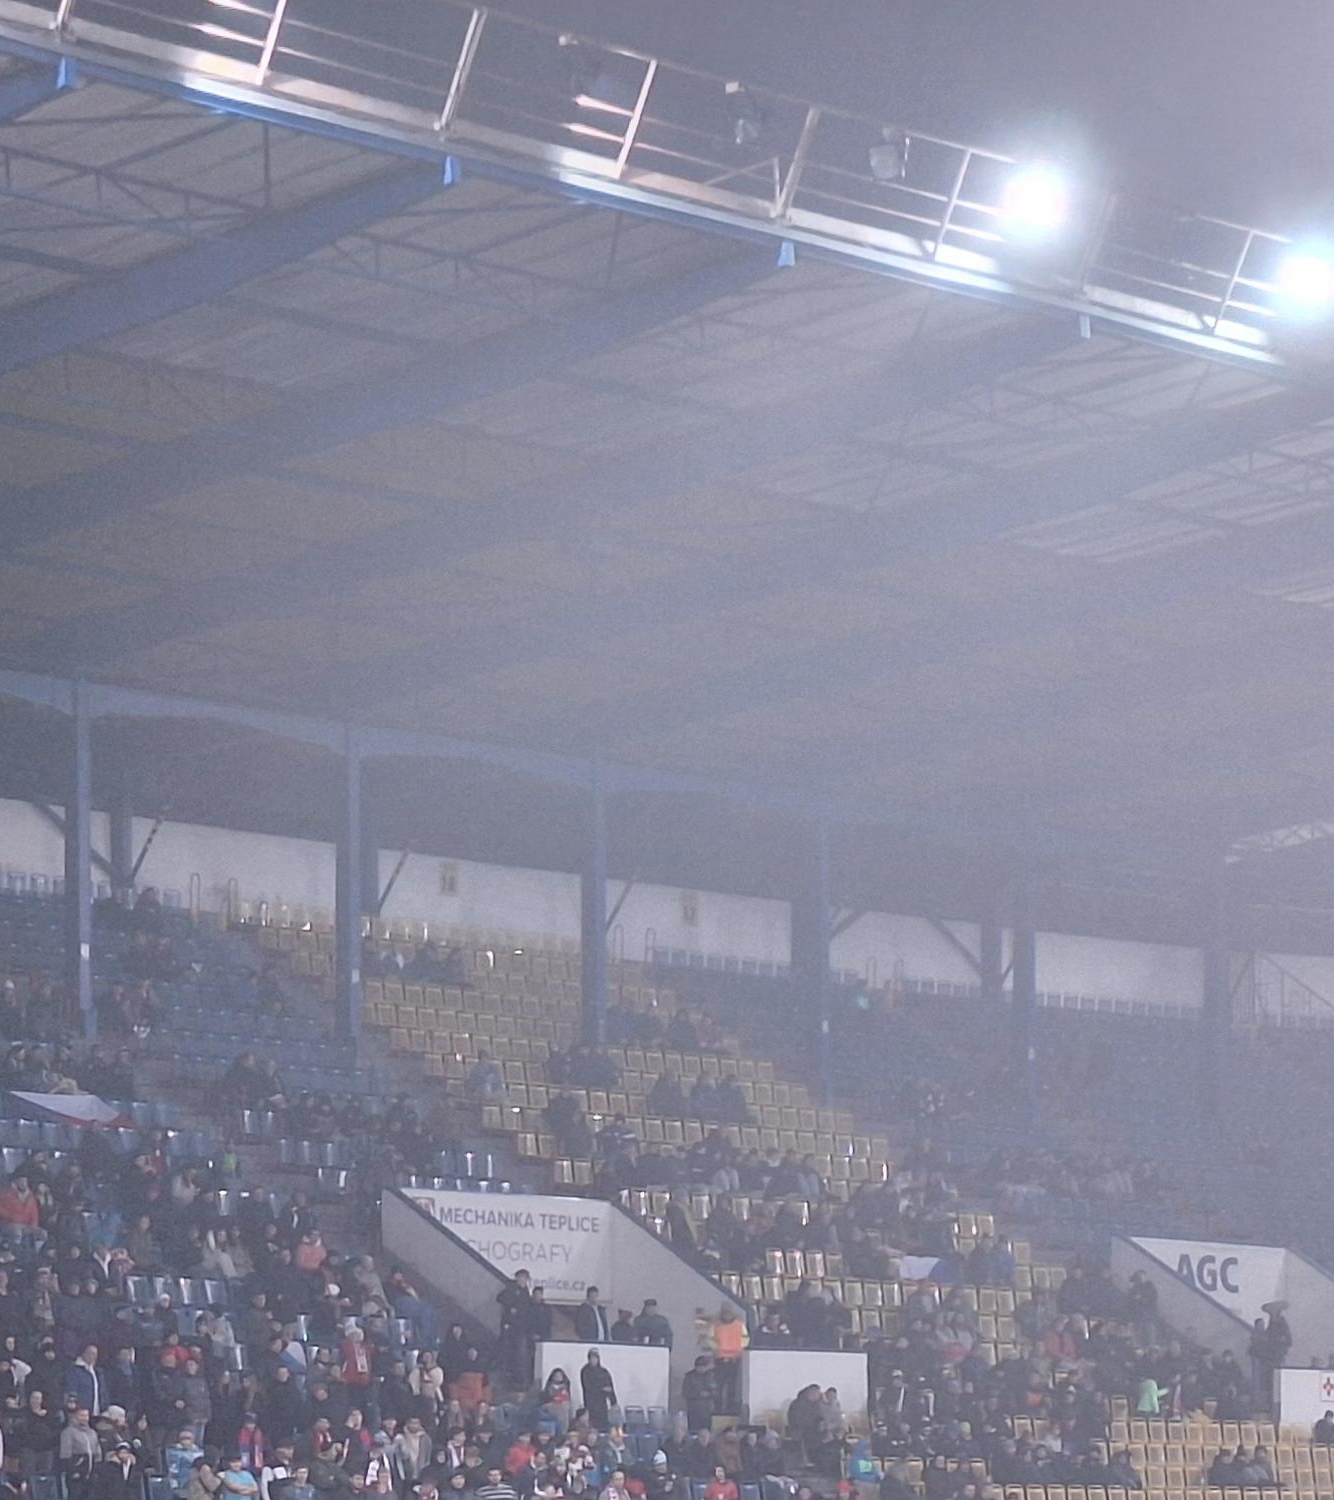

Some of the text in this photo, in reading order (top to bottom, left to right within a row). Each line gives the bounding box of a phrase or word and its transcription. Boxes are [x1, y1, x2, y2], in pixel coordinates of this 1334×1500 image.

[439, 1206, 600, 1233] MECHANIKA TEPLICE
[1177, 1253, 1239, 1293] AGC
